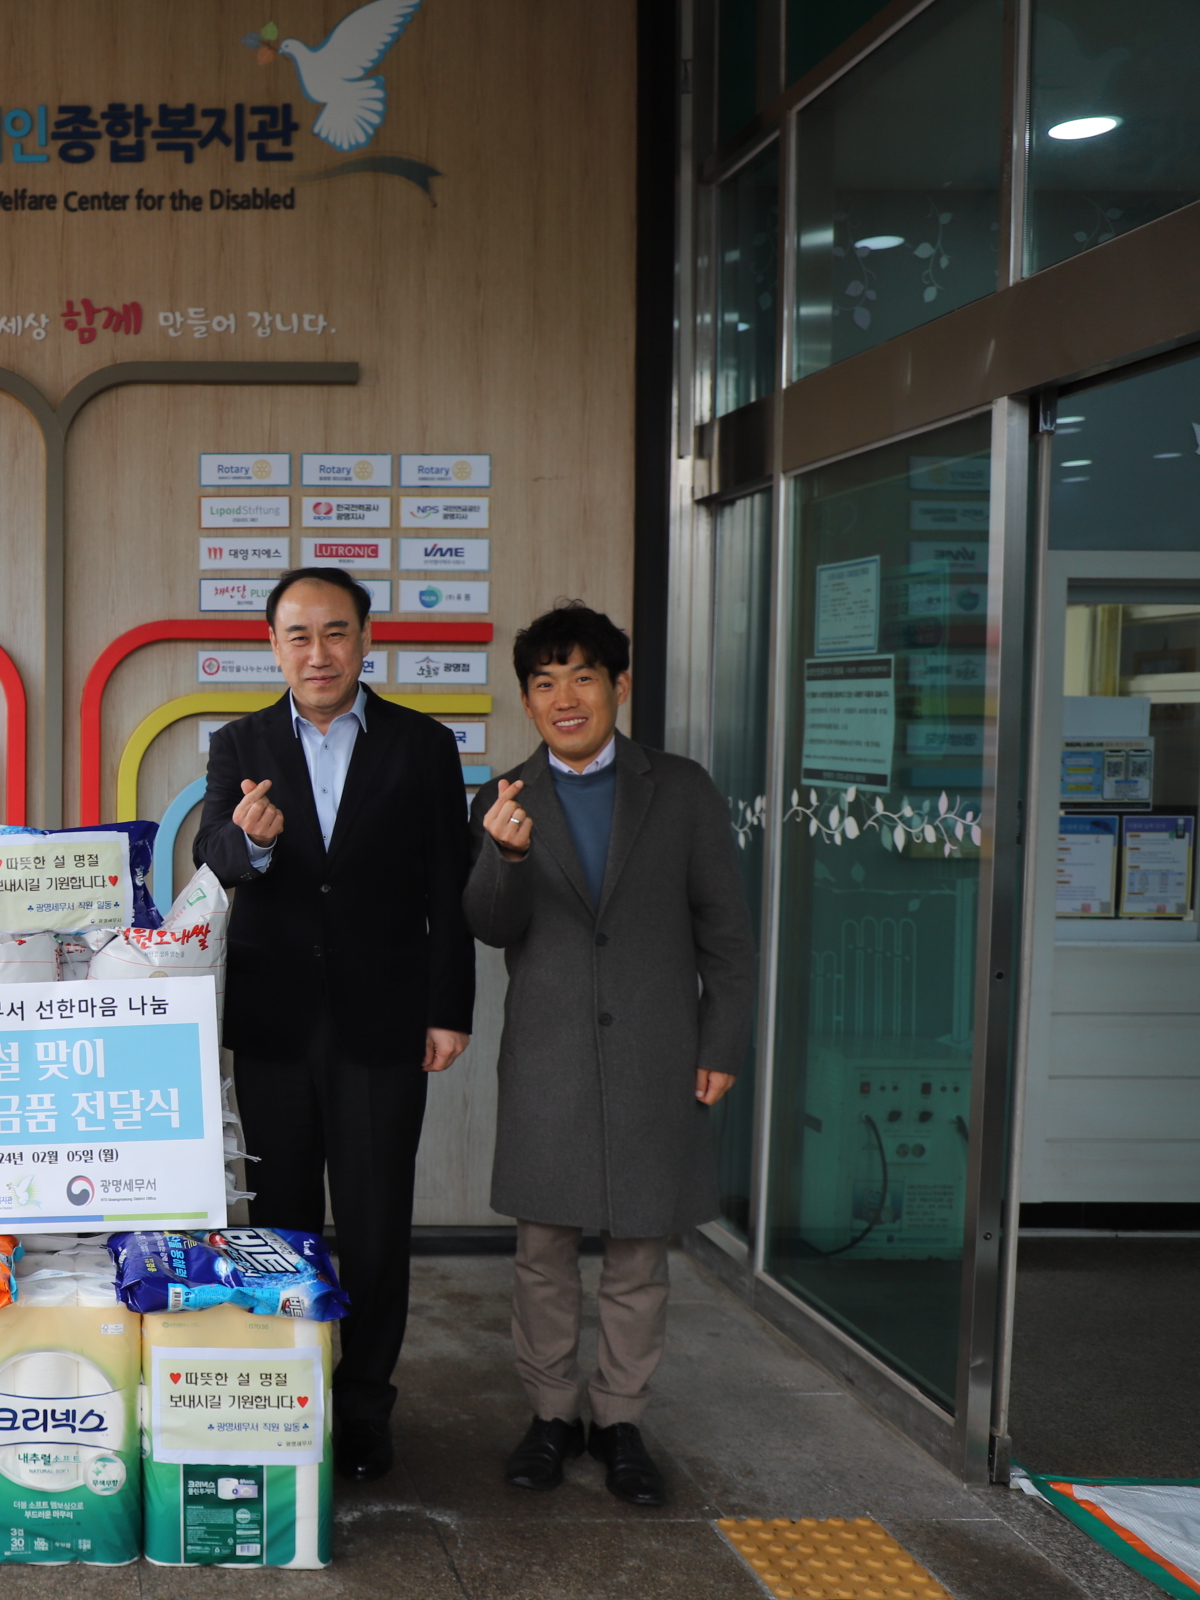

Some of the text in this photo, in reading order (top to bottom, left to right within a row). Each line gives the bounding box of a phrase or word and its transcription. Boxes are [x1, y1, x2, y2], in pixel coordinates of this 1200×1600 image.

[64, 190, 130, 213] Center
[136, 190, 164, 212] for
[170, 189, 203, 212] the
[209, 188, 295, 212] Disabled
[60, 299, 143, 344] 함께
[158, 309, 237, 337] 만들어
[247, 310, 337, 337] 갑니다.
[217, 464, 250, 475] Rotary
[319, 464, 351, 476] Rotary
[417, 465, 450, 476] Rotary
[336, 503, 380, 512] 한국전력공사
[417, 505, 440, 514] NPS
[336, 512, 365, 521] 광명지사
[229, 549, 282, 561] 대영 지에스
[315, 543, 377, 558] LUTRONIC
[214, 584, 247, 599] 채선당
[443, 663, 471, 673] 광명점
[6, 853, 100, 871] 따뜻한 설 명절
[46, 875, 108, 892] 기원합니다.
[36, 900, 112, 913] 광명세무서 직원 일동
[35, 998, 118, 1021] 선한마음
[128, 995, 170, 1016] 나눔
[34, 1037, 105, 1081] 맞이
[71, 1088, 181, 1133] 전달식
[31, 1150, 59, 1165] 02월
[66, 1149, 94, 1164] 05일
[97, 1147, 119, 1164] (월)
[100, 1177, 157, 1195] 광명세무서
[218, 1229, 301, 1273] 비트
[185, 1372, 288, 1388] 따뜻한 설 명절
[169, 1394, 296, 1410] 보내시길 기원합니다.
[217, 1422, 301, 1433] 광명세무서 직원 일동
[18, 1452, 82, 1466] 내추럴 소프트
[92, 1479, 119, 1488] 무색무향
[187, 1480, 216, 1488] 크리넥스
[13, 1501, 85, 1511] 더블 소프트 엠보싱으로
[24, 1510, 74, 1520] 부드러운 마무리
[10, 1527, 25, 1537] 3겹
[10, 1537, 25, 1547] 30
